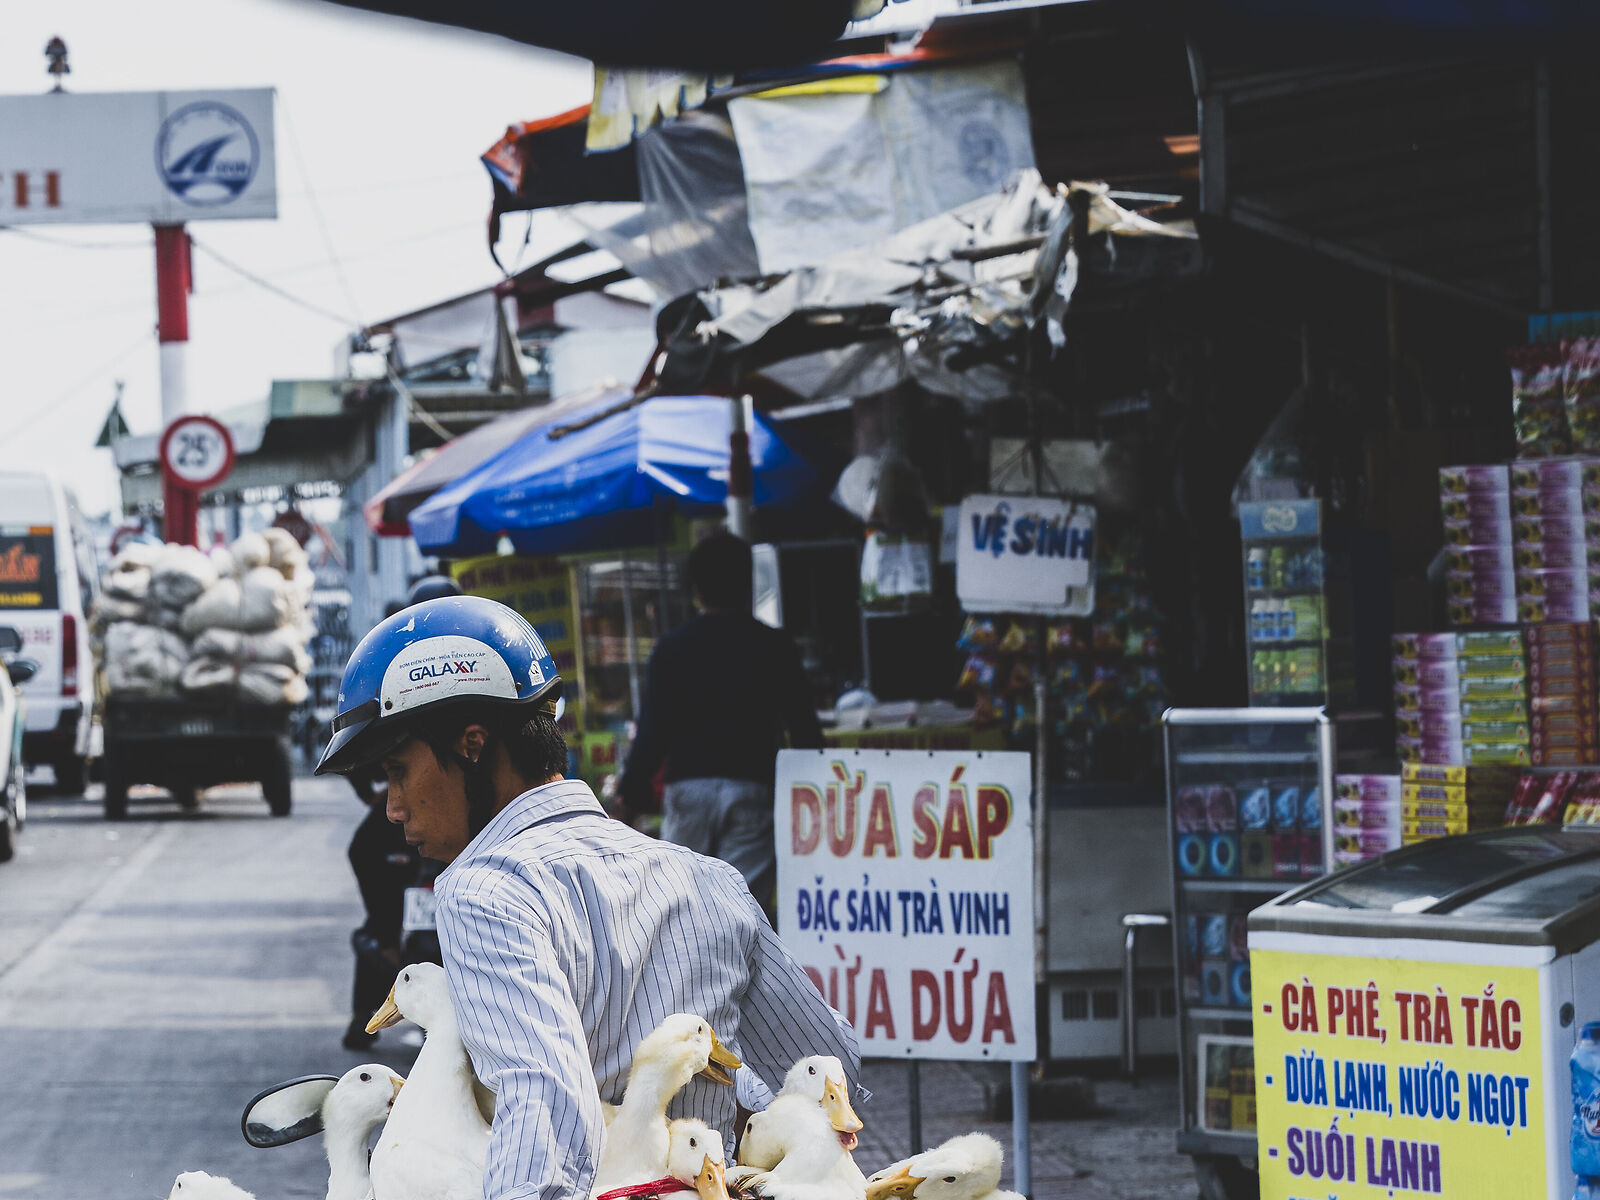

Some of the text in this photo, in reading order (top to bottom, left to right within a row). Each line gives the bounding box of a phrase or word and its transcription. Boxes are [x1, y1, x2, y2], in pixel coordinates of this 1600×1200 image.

[971, 501, 1092, 558] VỆ SINH
[409, 660, 476, 682] GALAXY
[791, 761, 1013, 860] DỪA SÁP
[797, 873, 1011, 943] ĐẶC SẢN TRÀ VINH
[911, 947, 1016, 1045] DỨA
[1281, 976, 1319, 1032] CÀ
[1327, 980, 1387, 1044] PHÊ,
[1395, 986, 1453, 1046] TRÀ
[1461, 981, 1523, 1051] TẮC
[1284, 1049, 1328, 1107] DỪA
[1333, 1059, 1393, 1119] LẠNH,
[1399, 1060, 1460, 1121] NƯỚC
[1468, 1072, 1530, 1137] NGỌT
[1287, 1115, 1356, 1183] SUỐI
[1366, 1136, 1442, 1198] LẠNH
